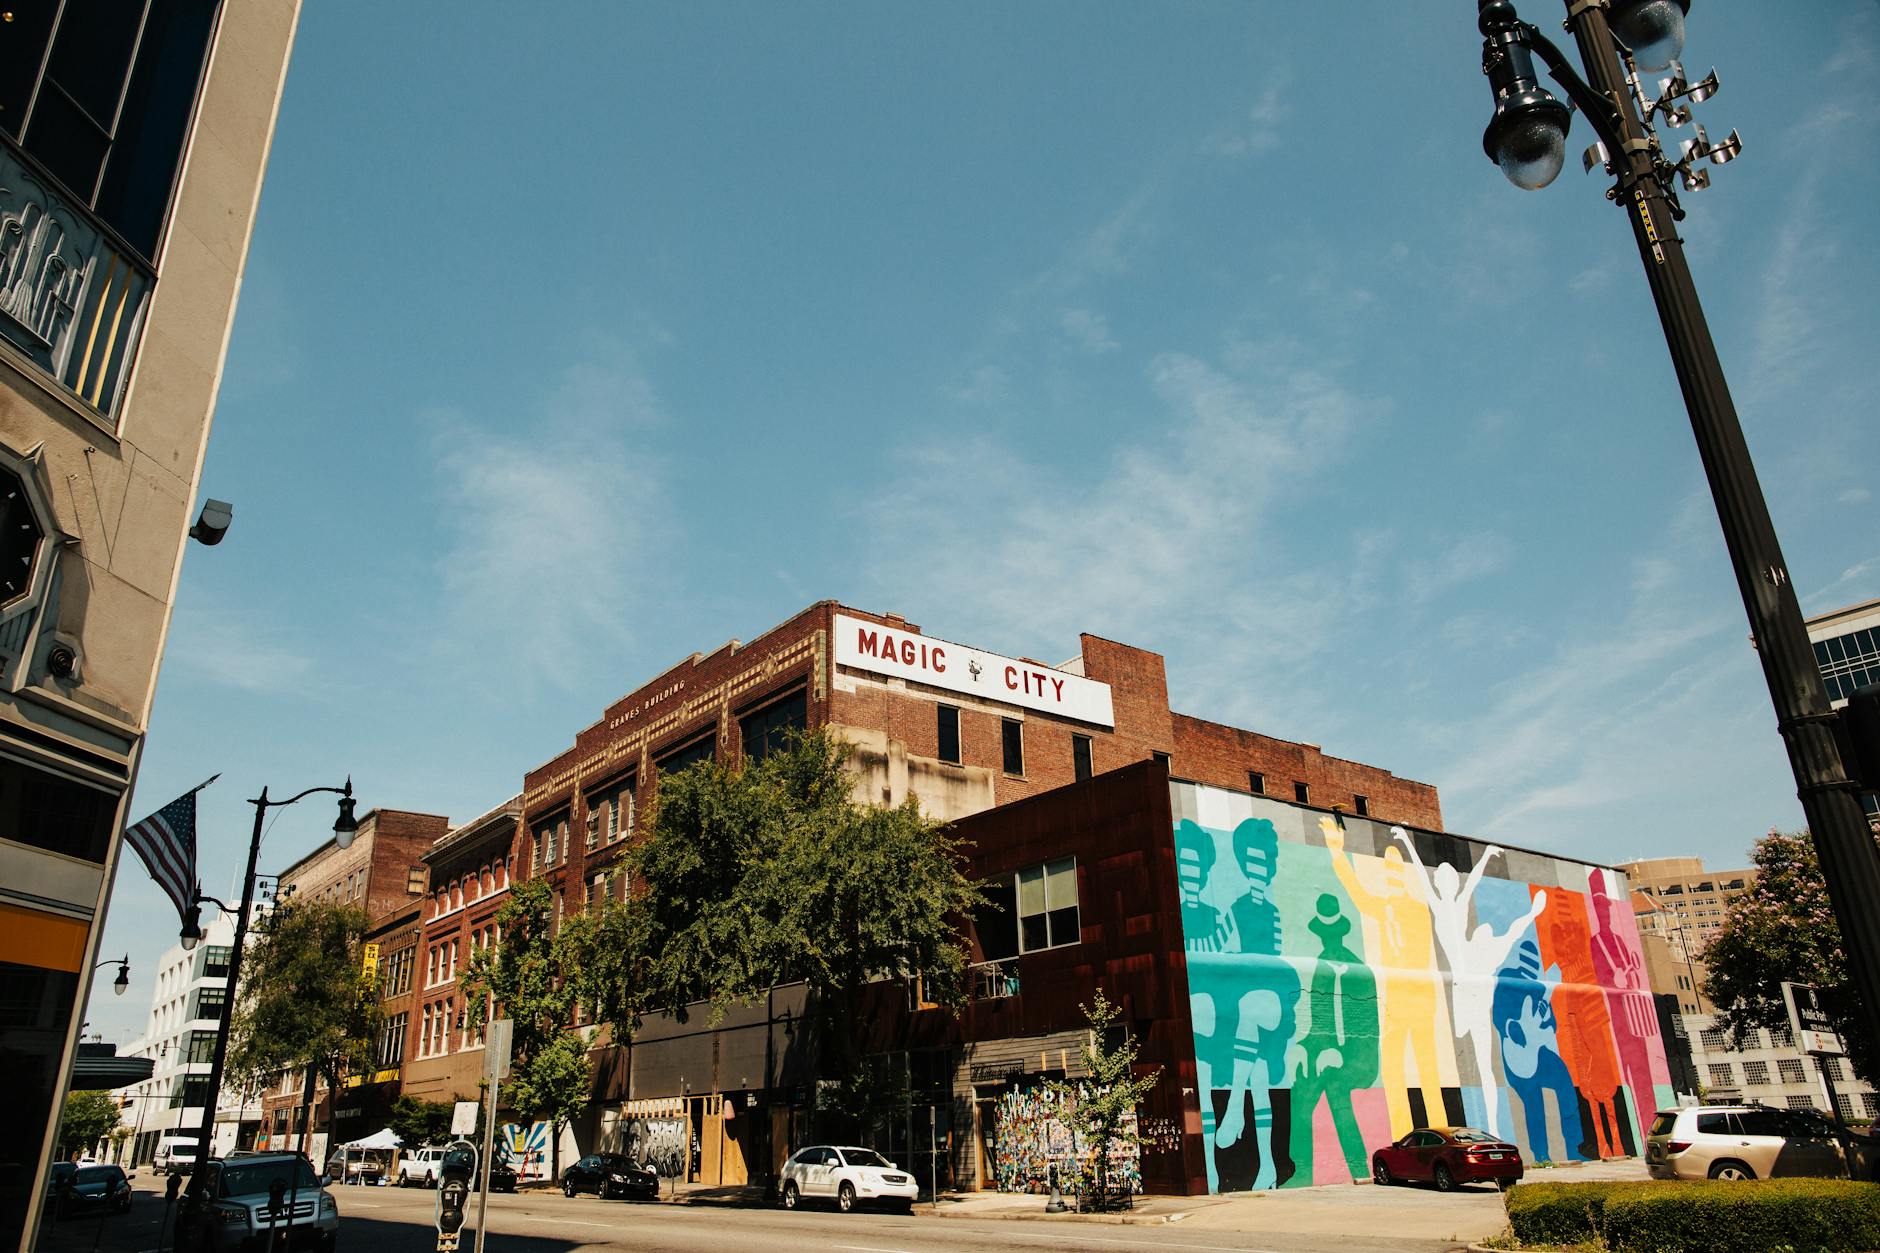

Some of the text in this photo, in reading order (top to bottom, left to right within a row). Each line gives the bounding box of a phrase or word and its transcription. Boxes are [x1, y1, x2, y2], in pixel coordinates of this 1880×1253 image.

[858, 628, 1065, 702] MAGIC CITY
[610, 680, 685, 730] GRAVES BUILDING
